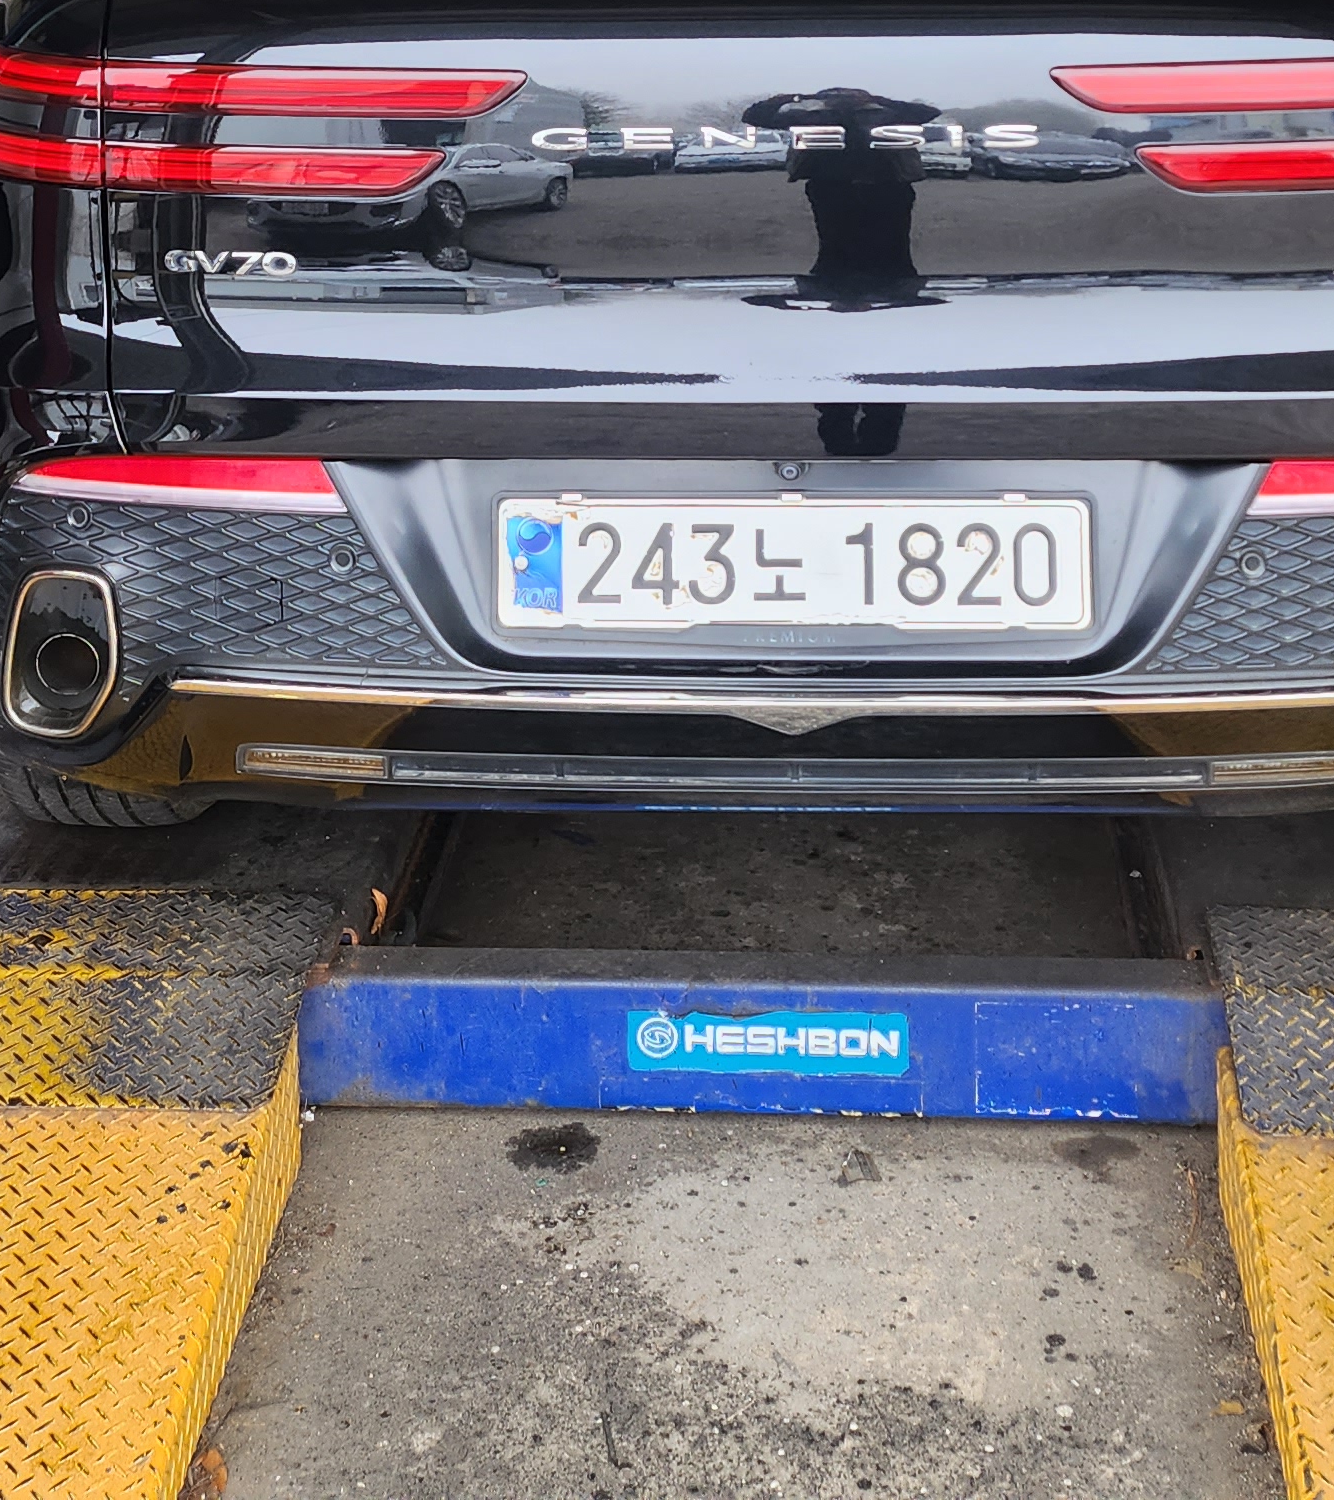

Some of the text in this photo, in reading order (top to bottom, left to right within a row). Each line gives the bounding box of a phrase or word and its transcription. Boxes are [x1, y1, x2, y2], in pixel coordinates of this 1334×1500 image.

[531, 124, 1040, 151] GENESIS
[164, 249, 297, 276] GV70
[577, 522, 1057, 607] 243노 1820
[513, 587, 558, 609] KOR
[743, 630, 837, 643] EMIUM
[684, 1024, 901, 1058] HESHBON
